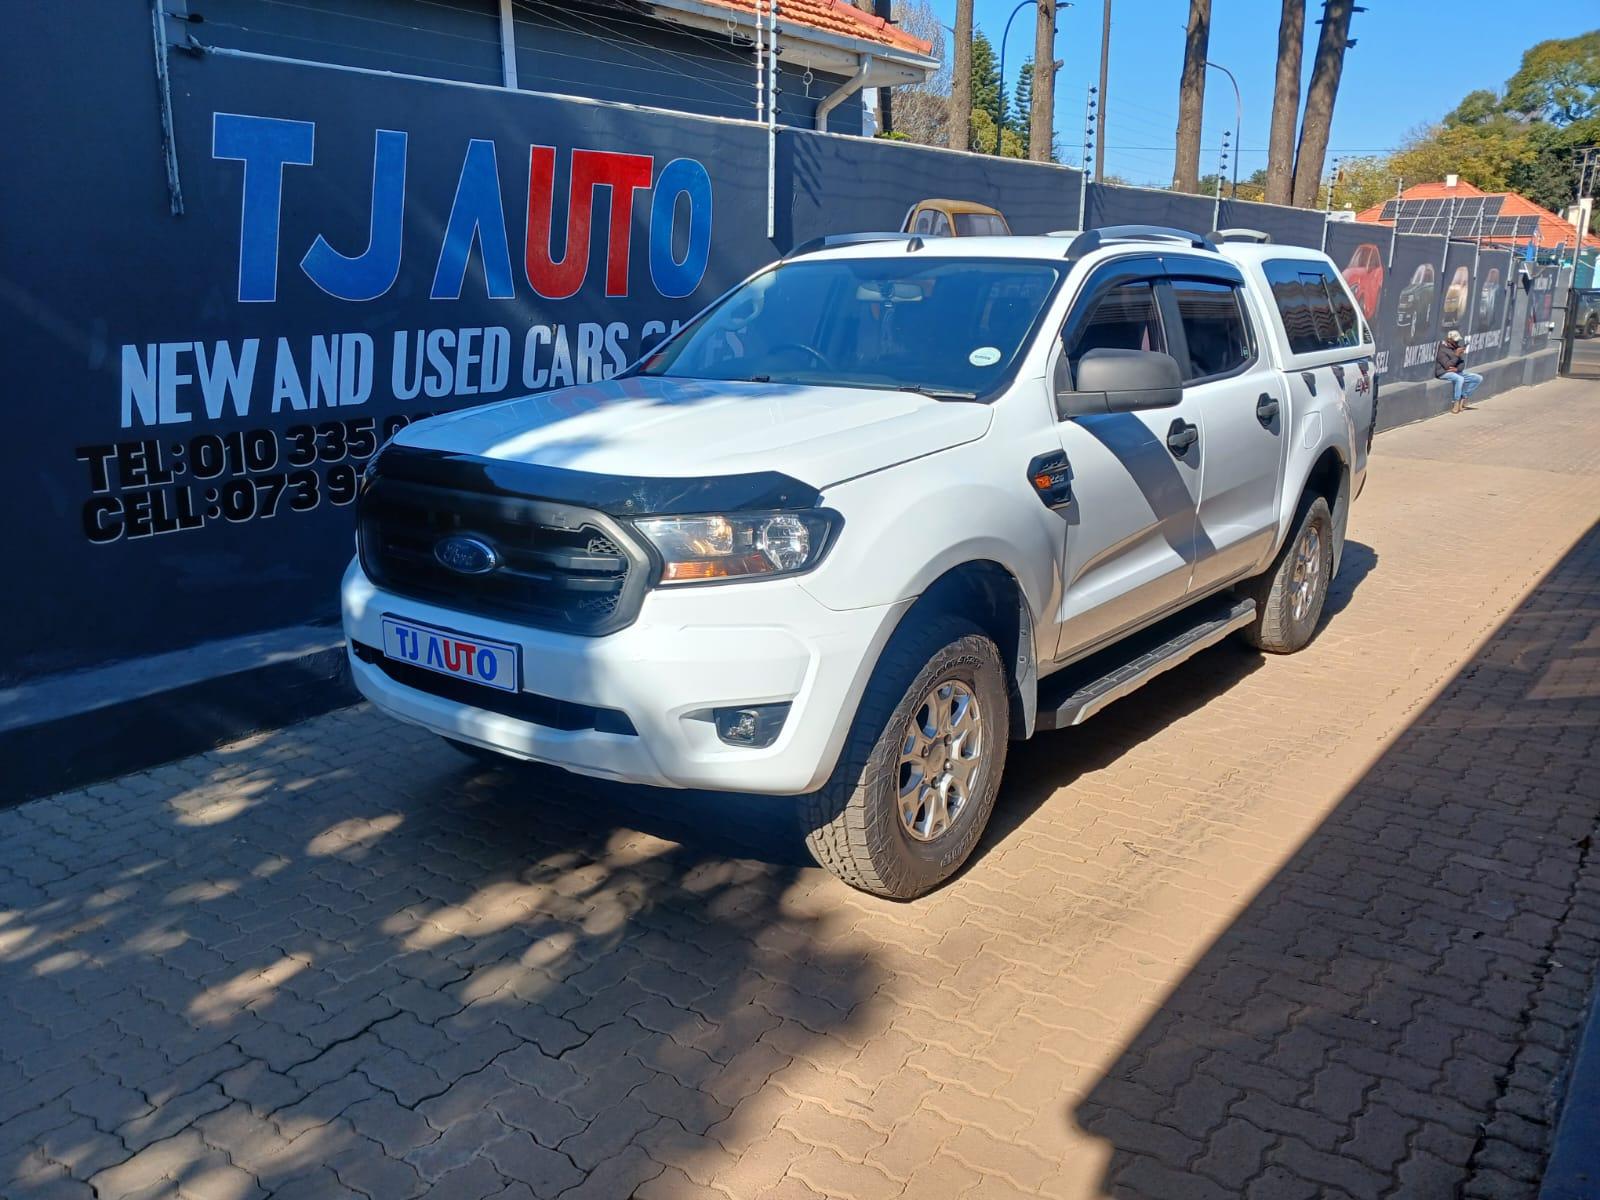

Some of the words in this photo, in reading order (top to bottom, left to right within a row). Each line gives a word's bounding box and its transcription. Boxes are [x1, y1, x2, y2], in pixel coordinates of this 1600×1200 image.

[429, 137, 713, 300] AUTO
[120, 337, 260, 429] NEW
[271, 333, 375, 413] AND
[391, 326, 509, 401] USED
[521, 321, 629, 387] CARS
[287, 416, 377, 468] 335
[396, 627, 419, 661] TJ
[427, 637, 498, 681] AUTO
